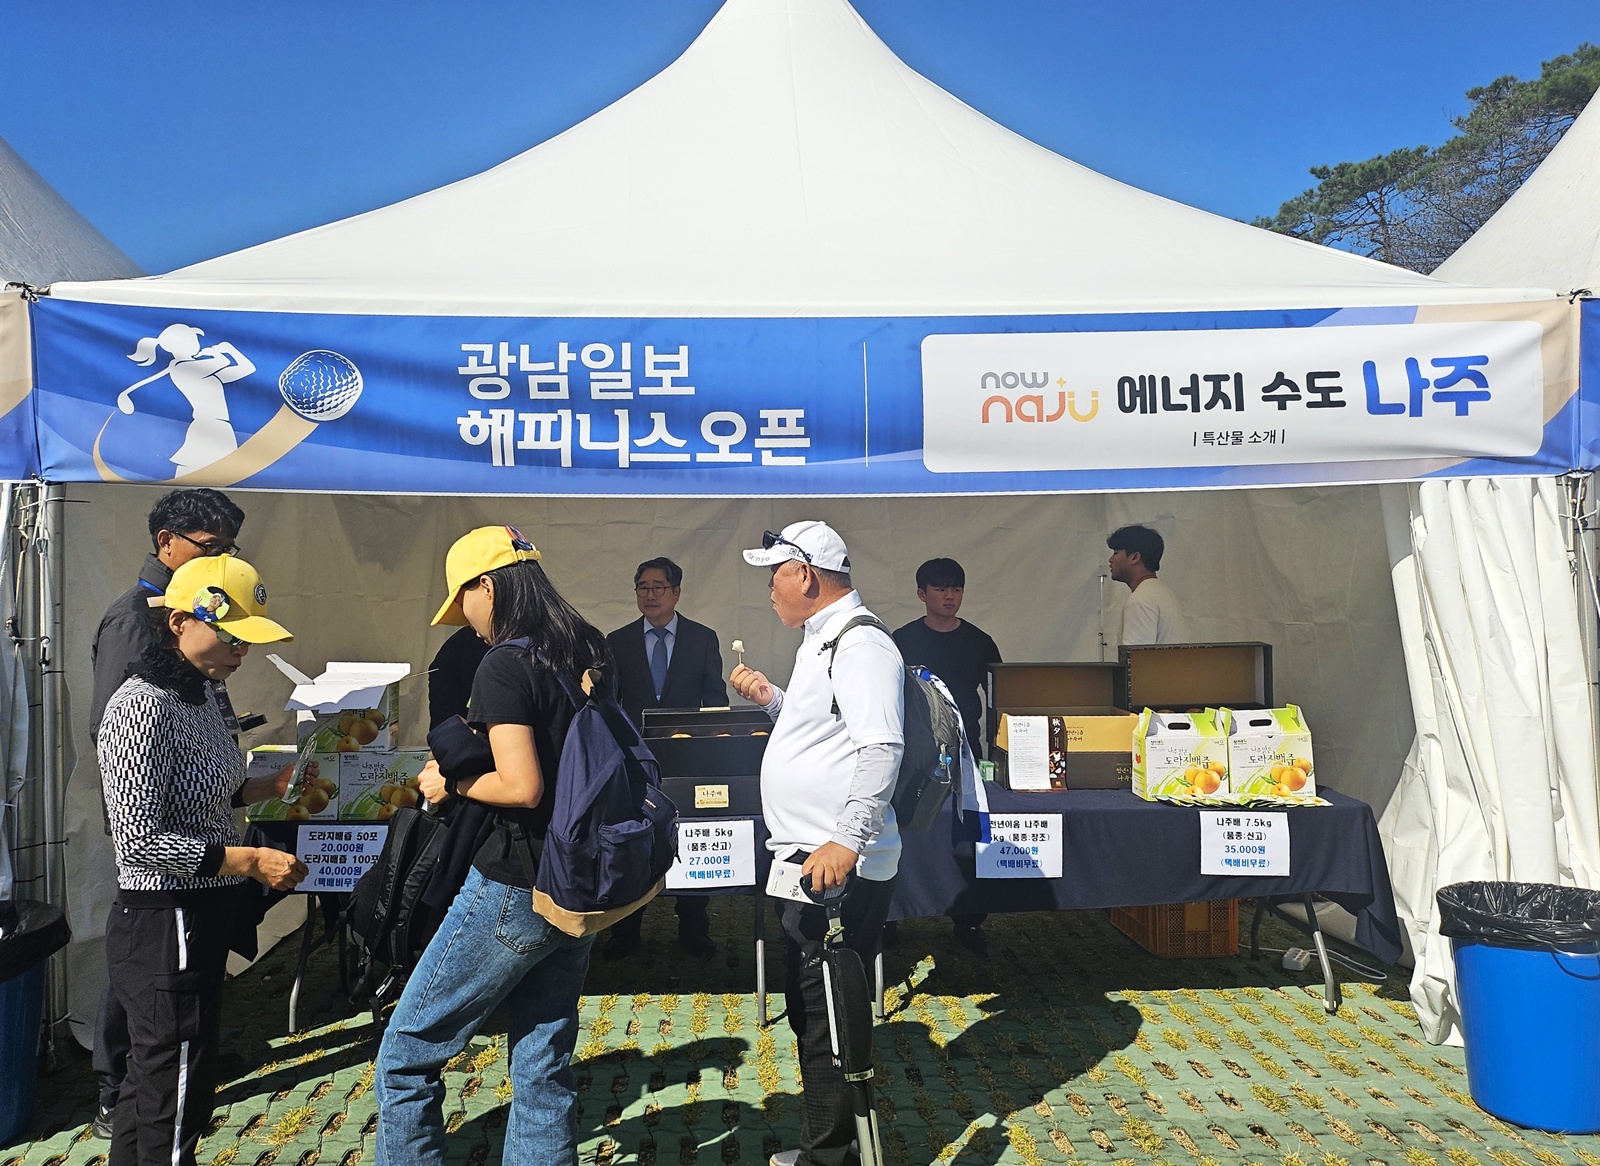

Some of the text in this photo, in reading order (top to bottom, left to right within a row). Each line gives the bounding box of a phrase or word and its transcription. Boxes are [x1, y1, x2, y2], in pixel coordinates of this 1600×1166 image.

[457, 341, 696, 400] 광남일보
[981, 371, 1049, 389] now
[1116, 354, 1492, 418] 에너지 수도 나주
[456, 408, 811, 468] 해피니스오픈
[1201, 429, 1277, 446] 특산물 소개
[358, 769, 408, 786] 도라지배즙
[1024, 820, 1048, 829] 나주배
[1216, 817, 1272, 828] 나주배 7.5kg
[309, 832, 378, 841] 도라지배즙 50포
[685, 828, 733, 837] 나주배 5kg
[1222, 831, 1267, 840] (품종:신고)
[990, 834, 1005, 842] kg
[321, 843, 364, 853] 20,000원
[687, 842, 732, 852] (품종:신고)
[1000, 846, 1039, 855] 47,000원
[304, 854, 347, 864] 도라지배즙
[996, 860, 1043, 868] (택배비무료)
[1220, 858, 1270, 868] (택배비무료)
[319, 866, 362, 876] 40,000원
[685, 869, 735, 879] (택배비무료)
